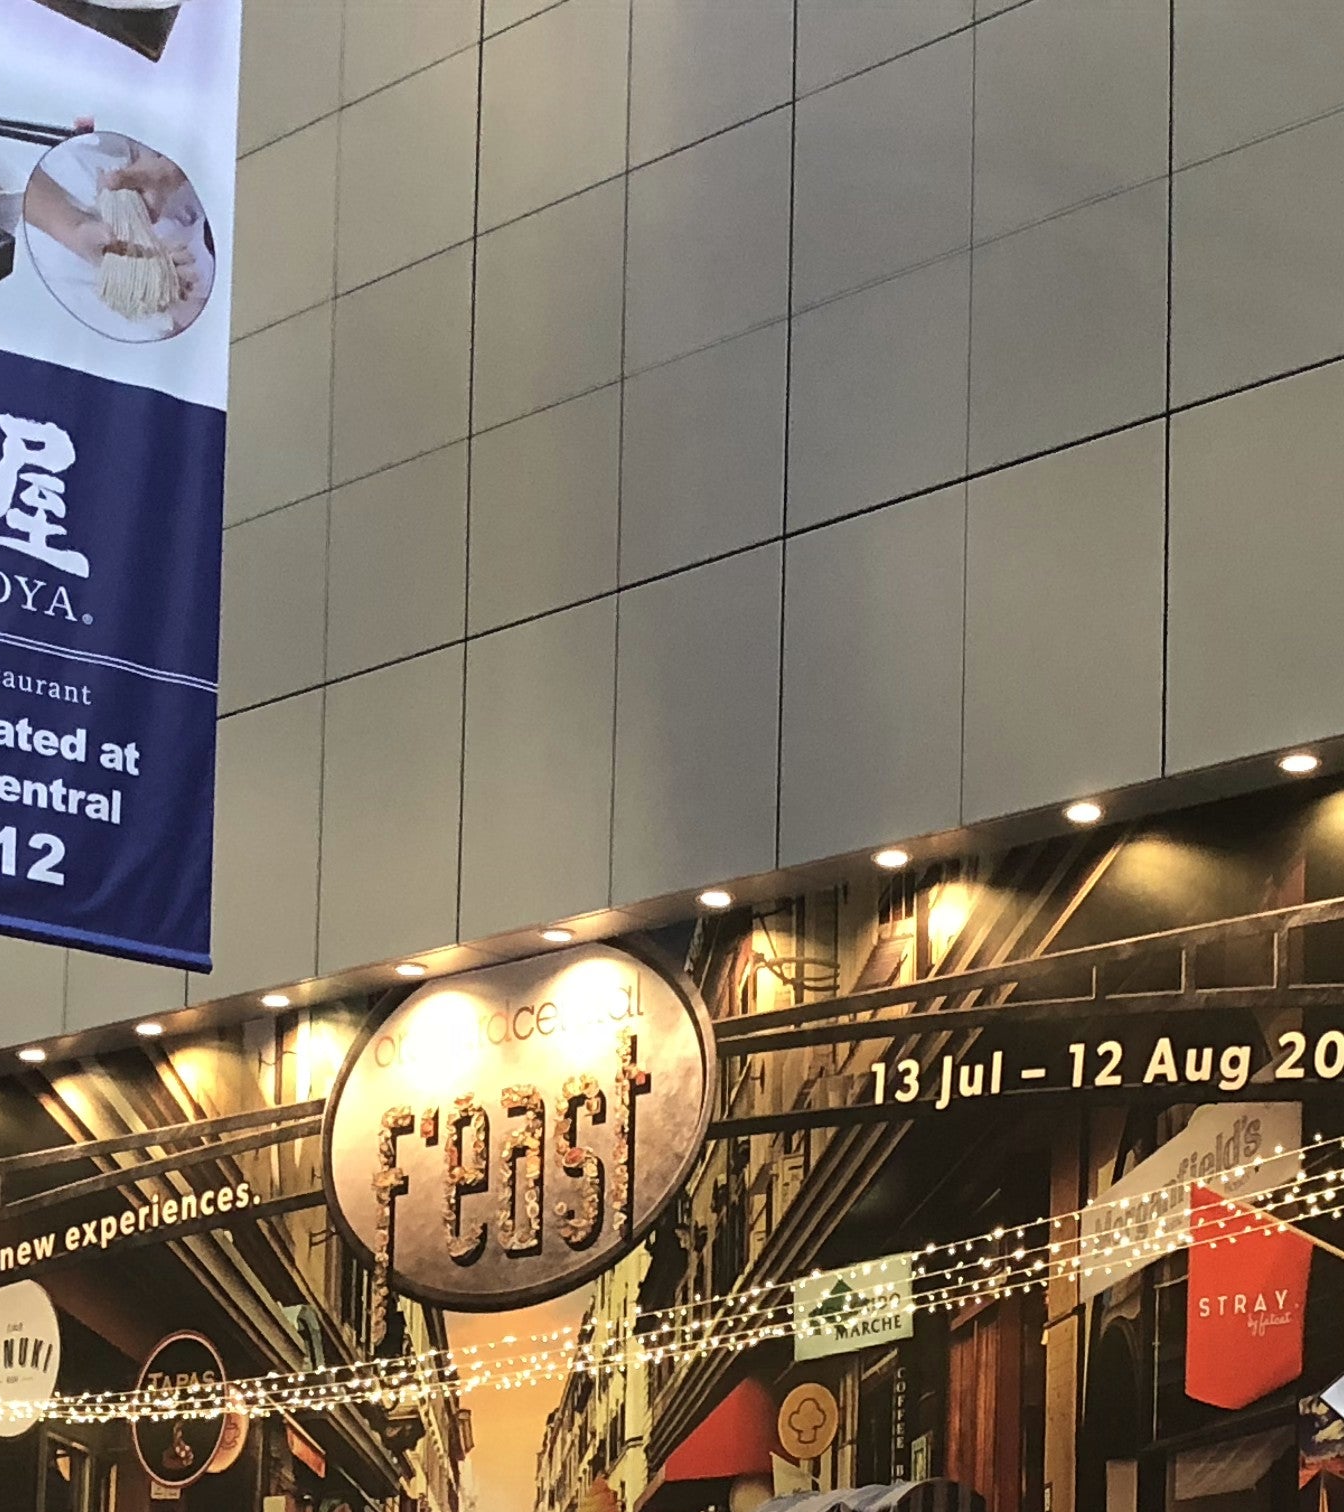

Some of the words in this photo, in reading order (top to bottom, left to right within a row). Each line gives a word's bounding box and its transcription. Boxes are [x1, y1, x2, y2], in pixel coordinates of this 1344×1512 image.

[100, 742, 141, 777] at
[870, 1056, 922, 1105] 13
[935, 1049, 1005, 1110] Jul
[1069, 1041, 1124, 1090] 12
[1144, 1035, 1253, 1091] Aug
[63, 1178, 262, 1252] experiences.
[1199, 1289, 1288, 1317] STRAY
[835, 1314, 903, 1342] MARCHE
